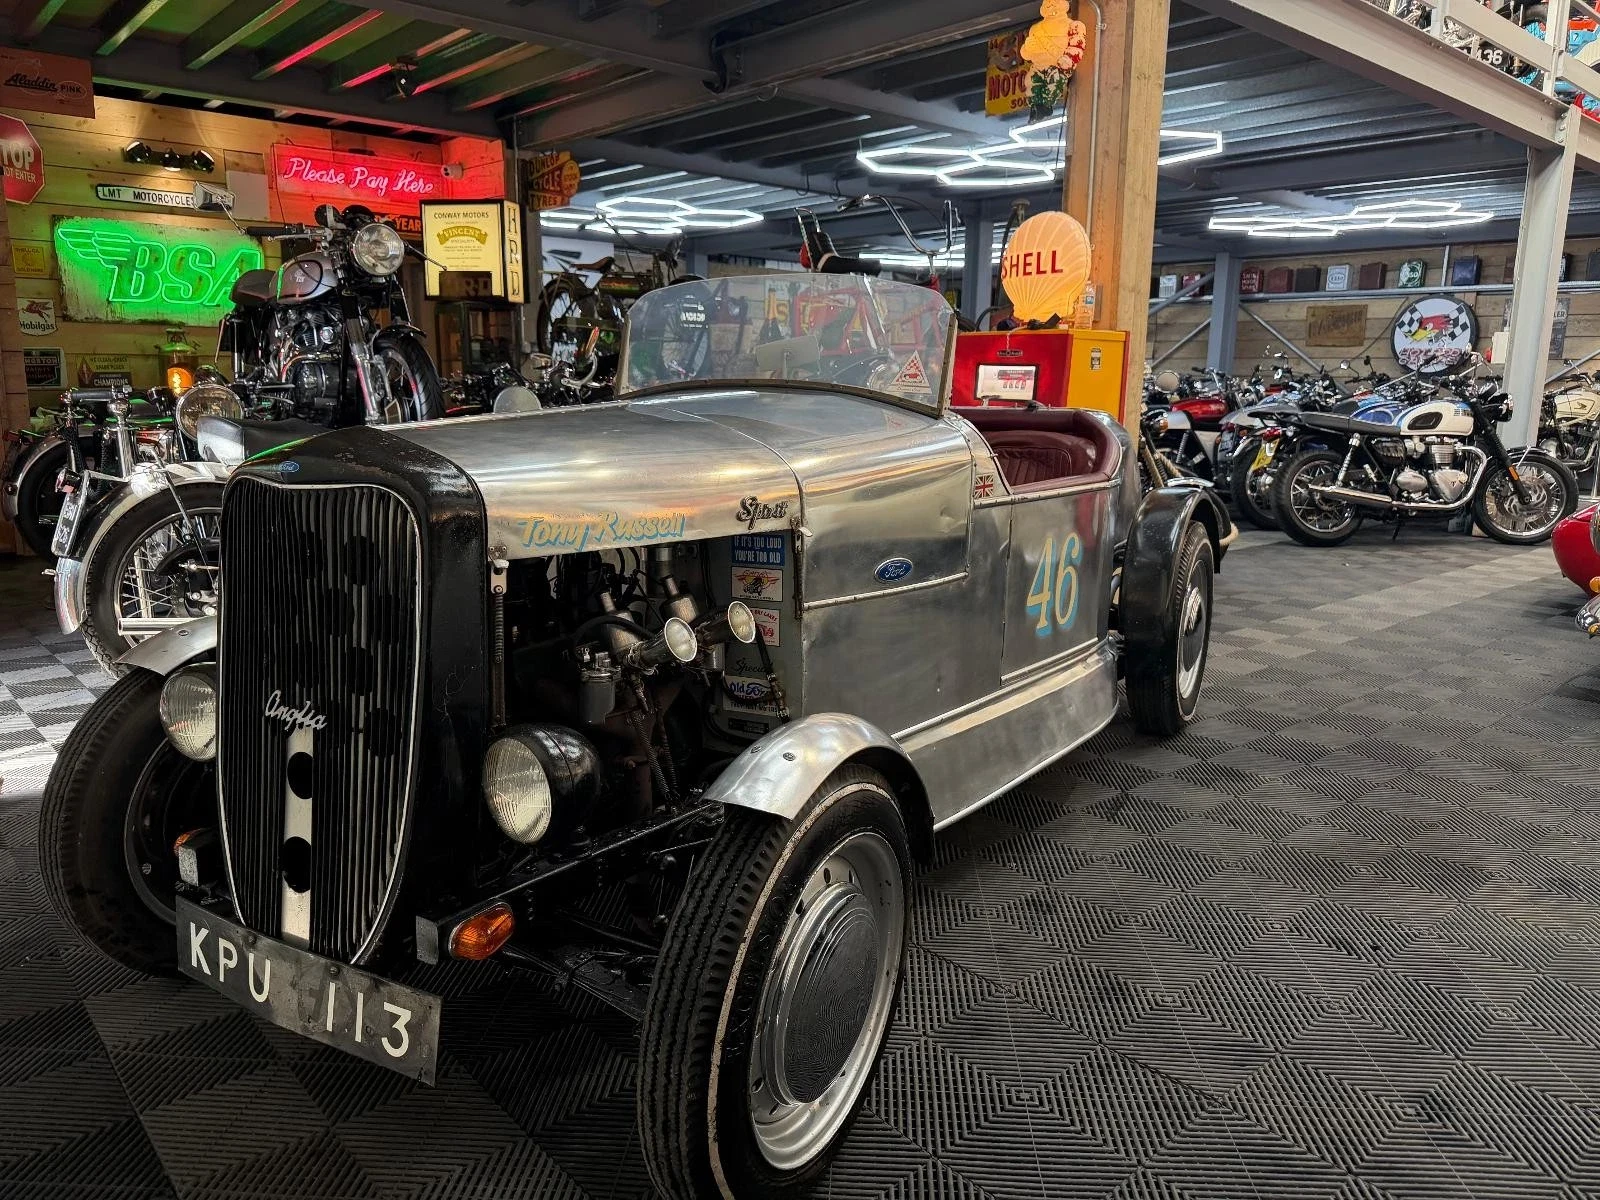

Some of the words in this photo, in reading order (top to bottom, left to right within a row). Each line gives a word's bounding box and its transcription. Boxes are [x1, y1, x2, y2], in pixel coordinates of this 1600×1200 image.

[3, 72, 58, 92] Aladdin
[61, 84, 82, 94] PINK
[989, 70, 1027, 101] MOTO
[1010, 97, 1028, 109] SOL
[0, 138, 34, 170] TOP
[530, 153, 560, 178] DUNLOP
[283, 157, 345, 185] Please
[349, 166, 388, 197] Pay
[392, 168, 434, 195] Here
[533, 170, 561, 190] CYCLE
[102, 187, 122, 199] LMT
[530, 194, 558, 211] TYRES
[434, 212, 461, 220] CONWAY
[462, 211, 489, 219] MOTORS
[109, 241, 263, 307] BSA
[1001, 250, 1063, 279] SHELL
[518, 518, 590, 551] Tony
[595, 511, 686, 542] Russell
[734, 535, 739, 547] IF
[741, 536, 751, 548] IT'S
[754, 536, 764, 548] TOO
[766, 537, 782, 549] LOUD
[735, 549, 755, 562] YOU'RE
[756, 550, 767, 563] TOO
[769, 551, 781, 563] OLD
[1025, 531, 1083, 638] 46
[730, 681, 744, 693] Old
[265, 690, 328, 731] Anglia
[189, 921, 271, 1003] KPU
[327, 982, 412, 1058] 113
